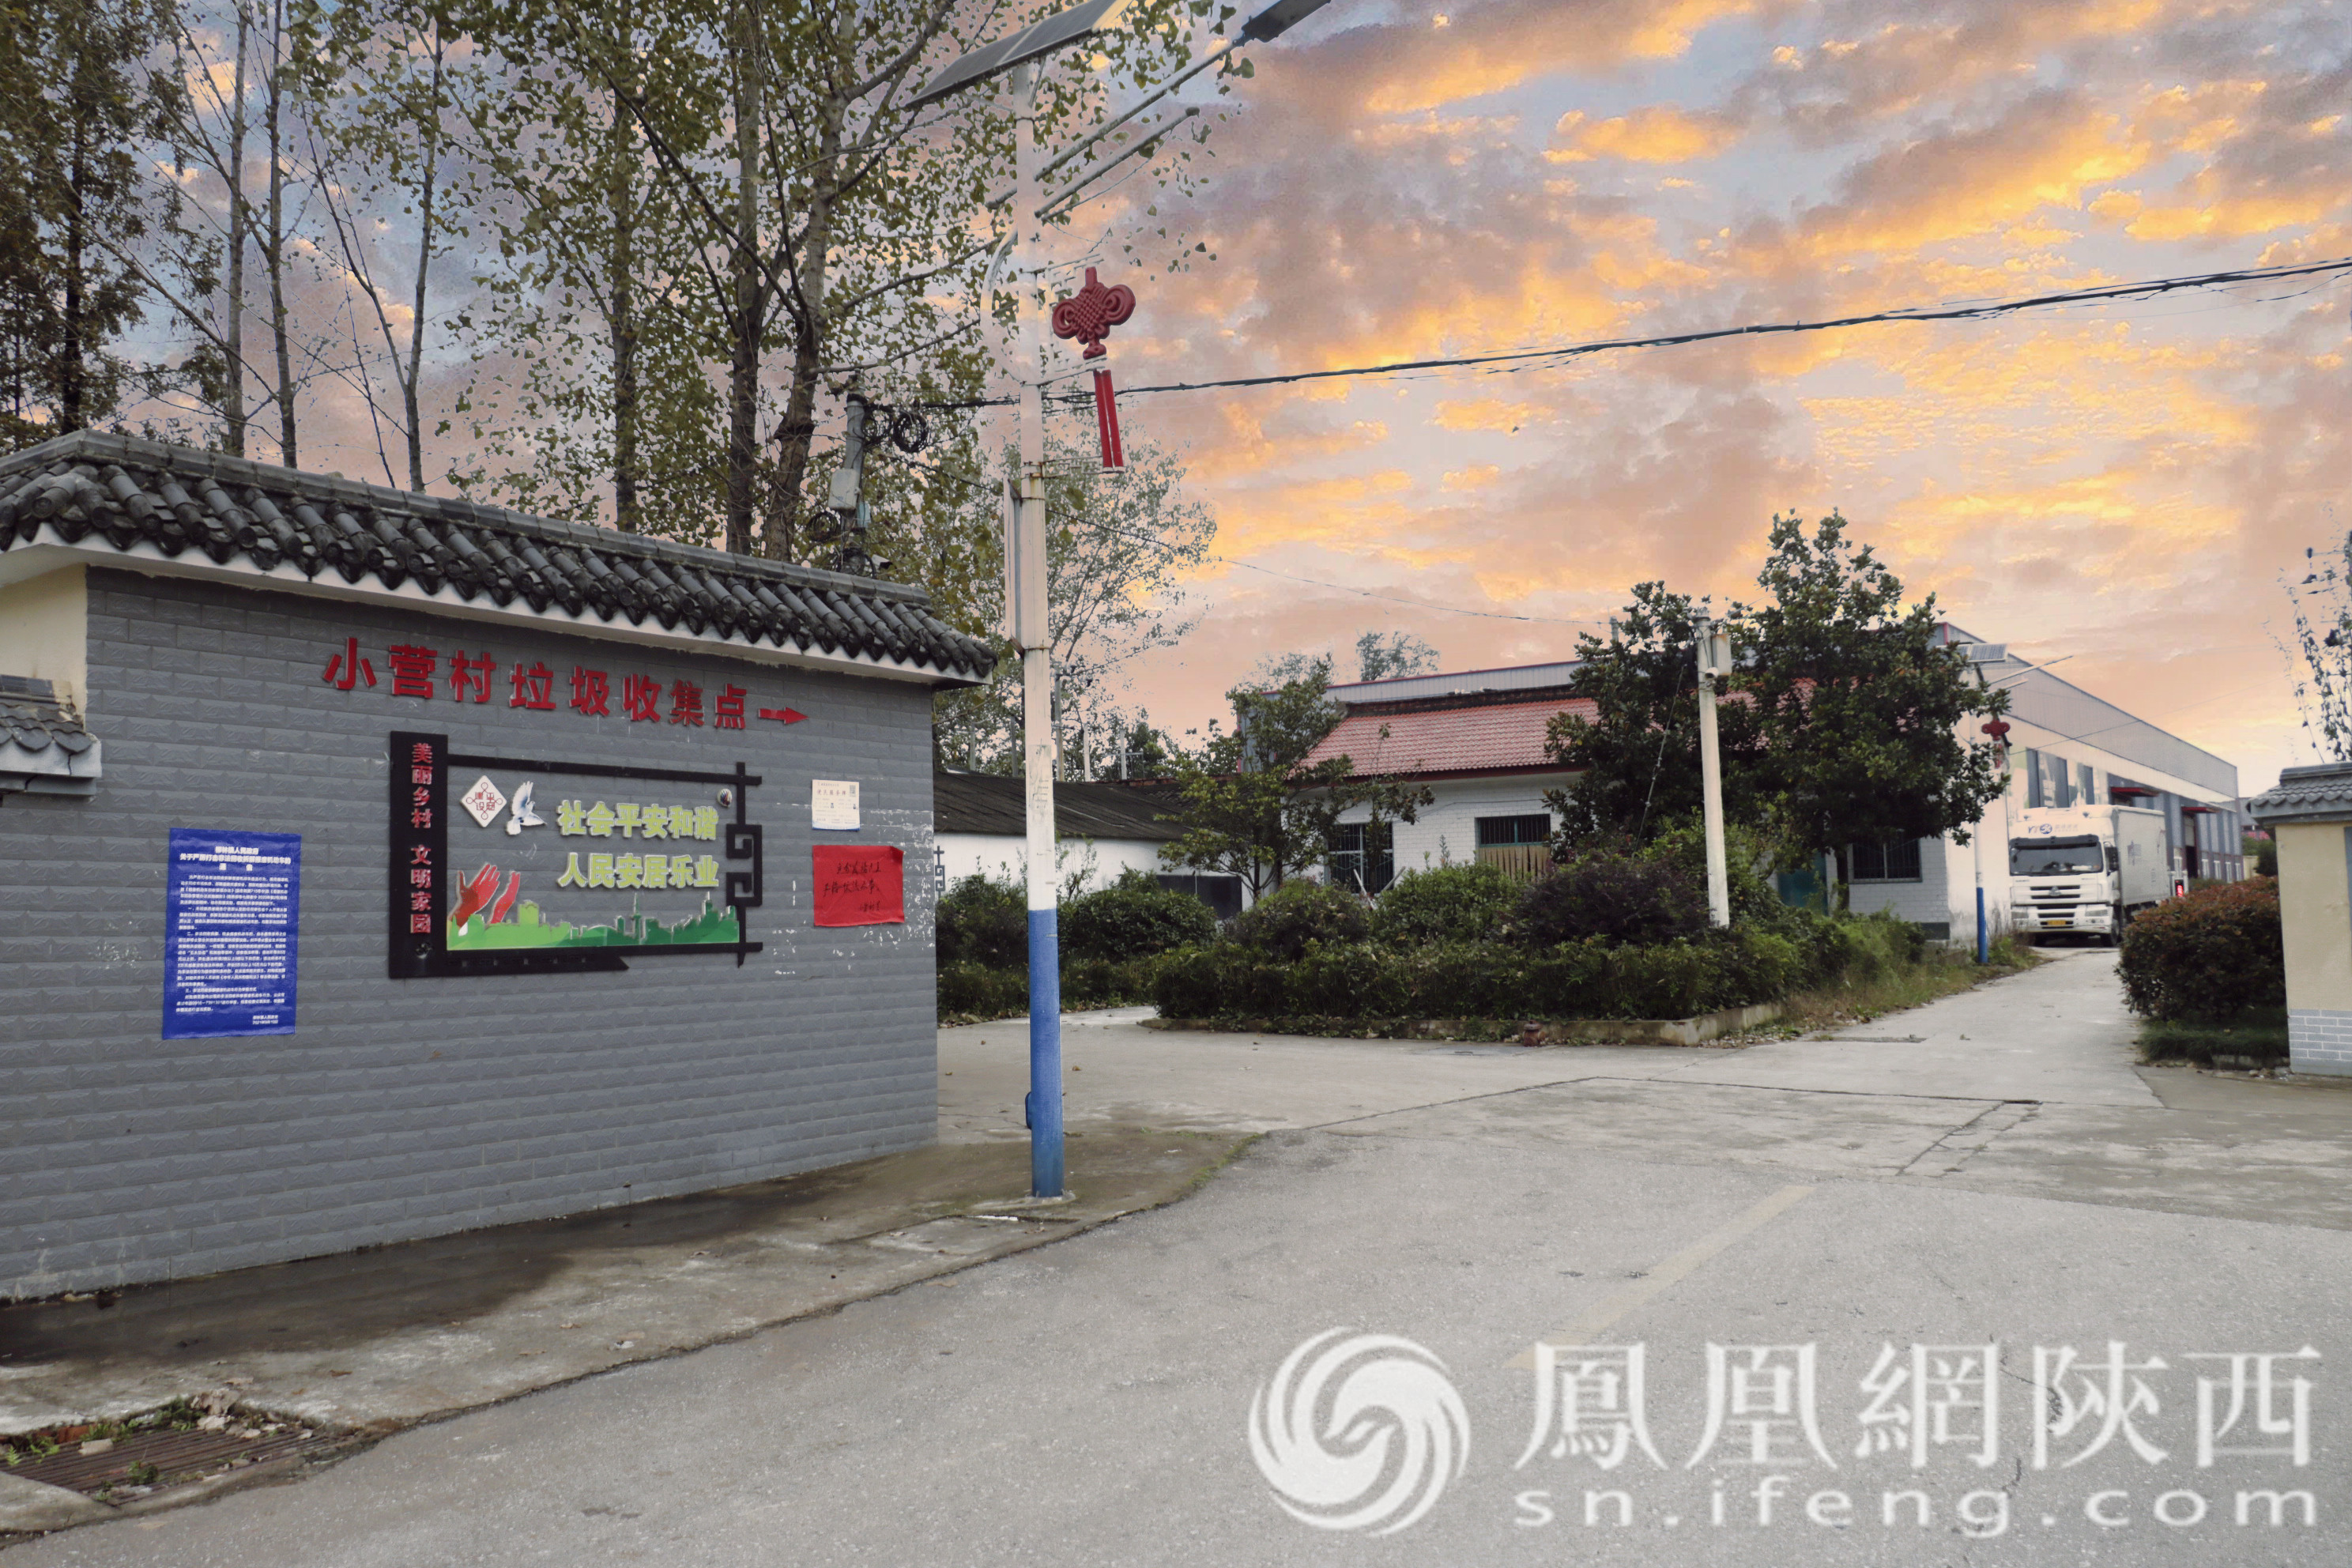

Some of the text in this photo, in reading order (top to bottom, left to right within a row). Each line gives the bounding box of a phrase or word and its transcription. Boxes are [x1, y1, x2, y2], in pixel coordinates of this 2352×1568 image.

[322, 637, 747, 729] 小营村垃圾收集点
[409, 742, 433, 934] 美丽乡村 文明家园
[557, 800, 719, 841] 社会平安和谐
[557, 852, 719, 889] 人民安居乐业
